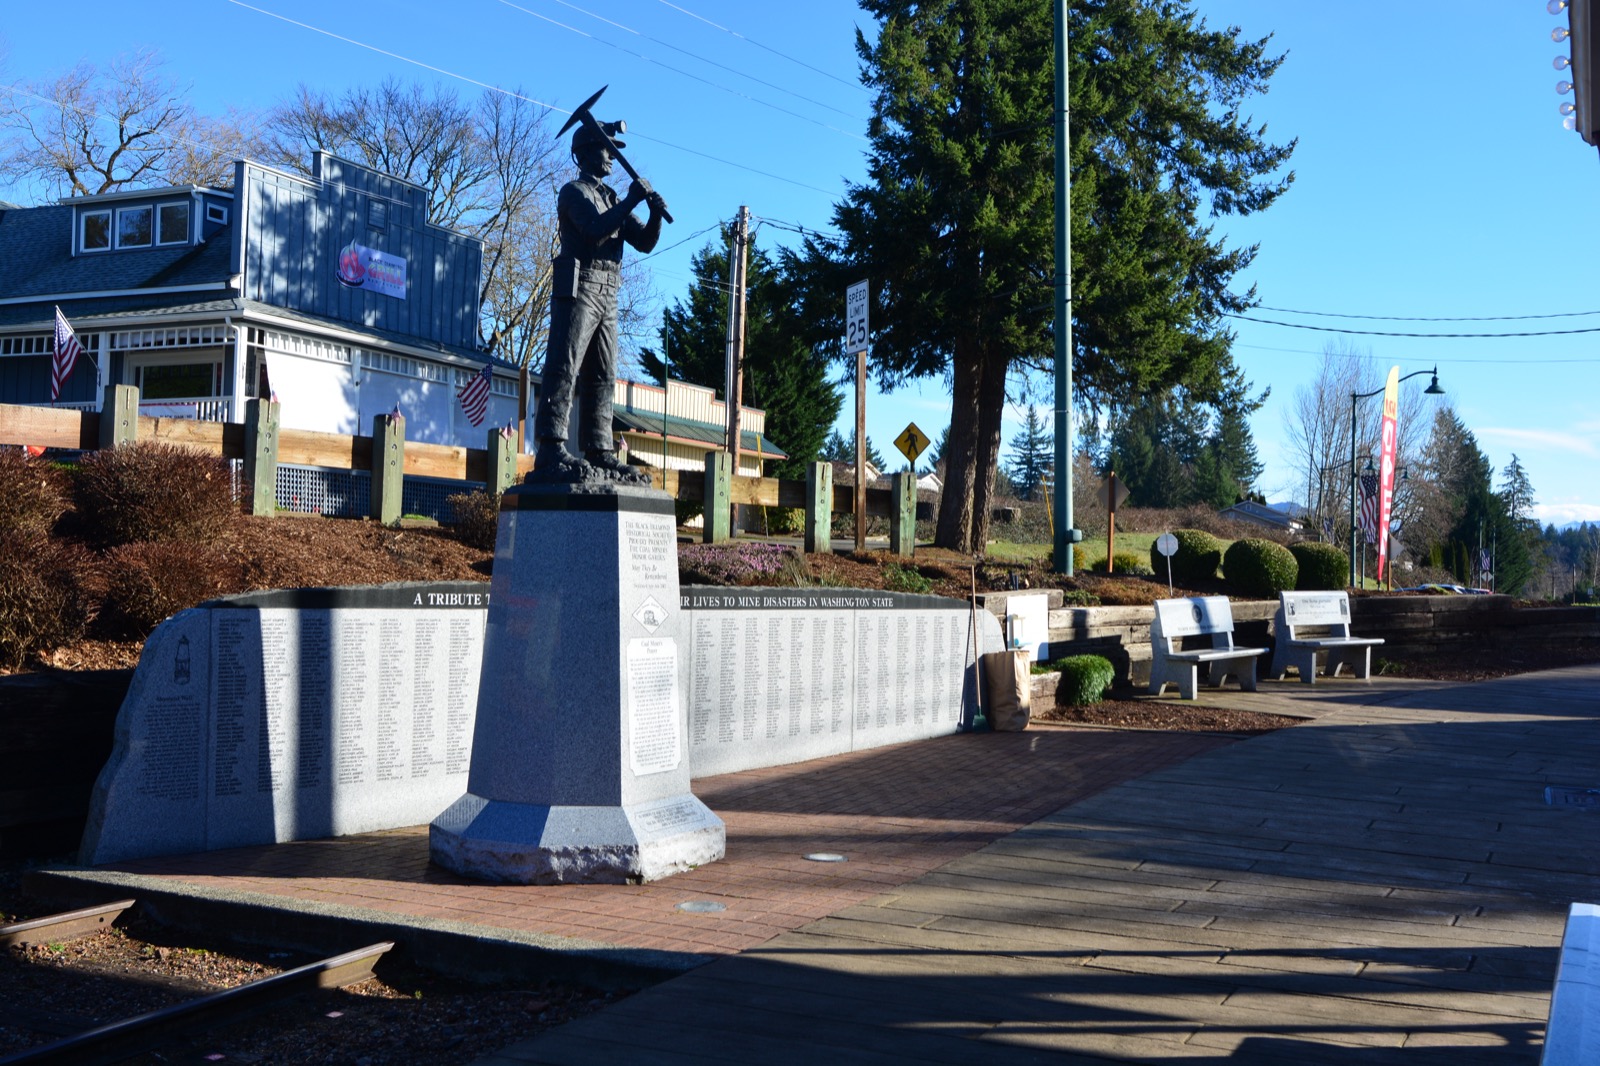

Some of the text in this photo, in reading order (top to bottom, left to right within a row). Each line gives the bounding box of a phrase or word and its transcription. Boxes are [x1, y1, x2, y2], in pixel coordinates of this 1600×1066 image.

[368, 263, 404, 286] GRILL
[848, 288, 866, 304] SPEED
[850, 304, 864, 318] LIMIT
[848, 318, 866, 347] 25
[413, 592, 423, 605] A
[428, 592, 482, 606] TRIBUTE
[693, 596, 720, 607] LIVES
[723, 596, 735, 607] TO
[738, 596, 760, 607] MINE
[763, 596, 807, 607] DISASTERS
[809, 597, 818, 607] IN
[820, 597, 870, 608] WASHINGTON
[872, 597, 894, 608] STATE
